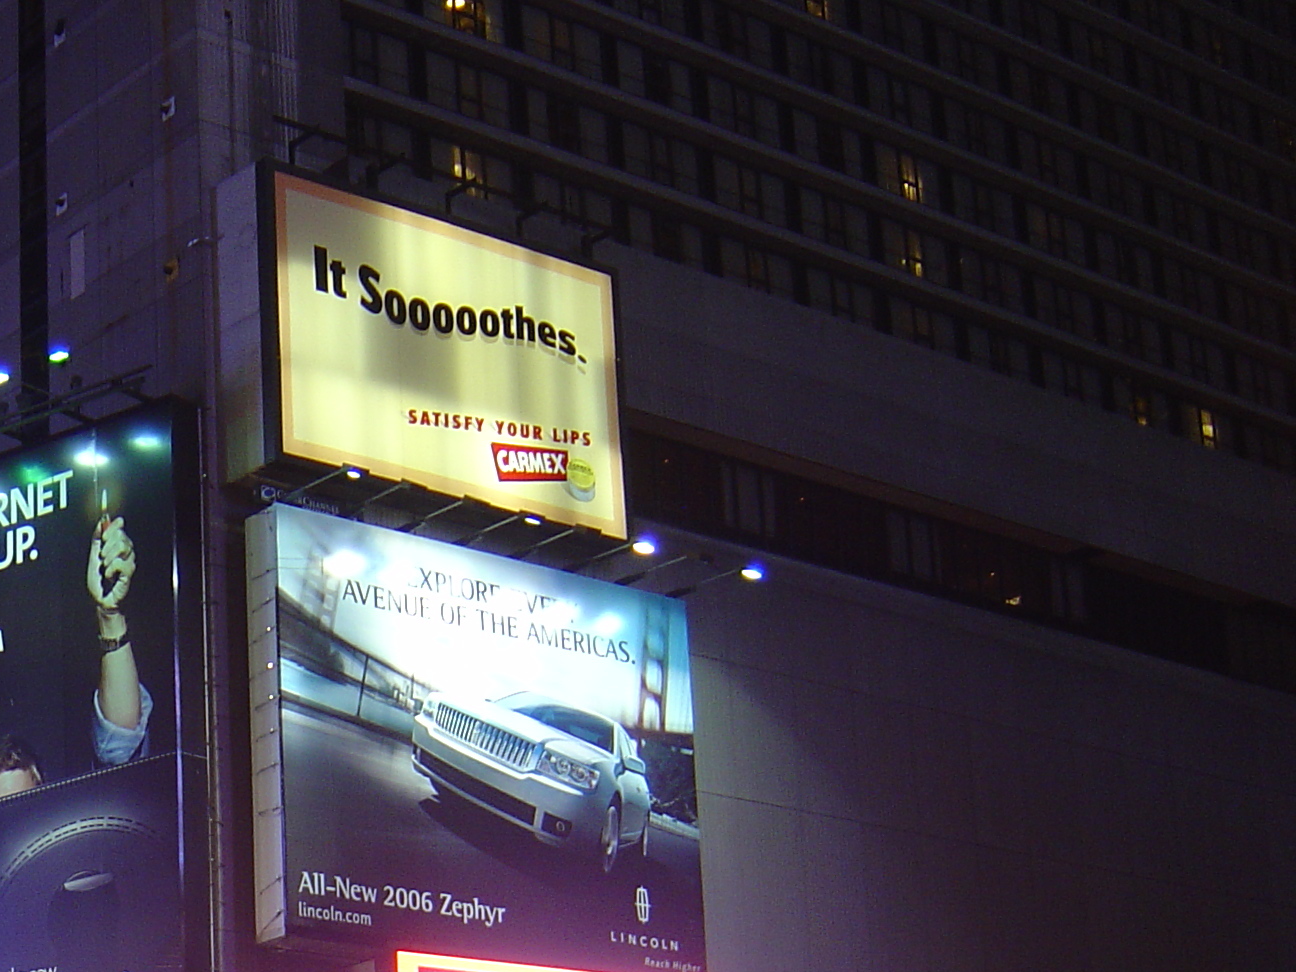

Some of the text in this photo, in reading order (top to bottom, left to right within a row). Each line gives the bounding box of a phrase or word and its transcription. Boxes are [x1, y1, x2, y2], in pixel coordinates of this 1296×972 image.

[313, 244, 588, 365] It Sooooothes.
[407, 408, 592, 447] SATISFY YOUR LIPS
[496, 448, 566, 475] CARMEX
[341, 578, 432, 622] AVENUE
[440, 602, 468, 629] OF
[476, 607, 519, 640] THE
[526, 621, 636, 665] AMERICAS.
[297, 901, 373, 927] lincoln.com
[298, 870, 507, 928] All-New 2006 Zephyr
[609, 930, 680, 952] LINCOLN
